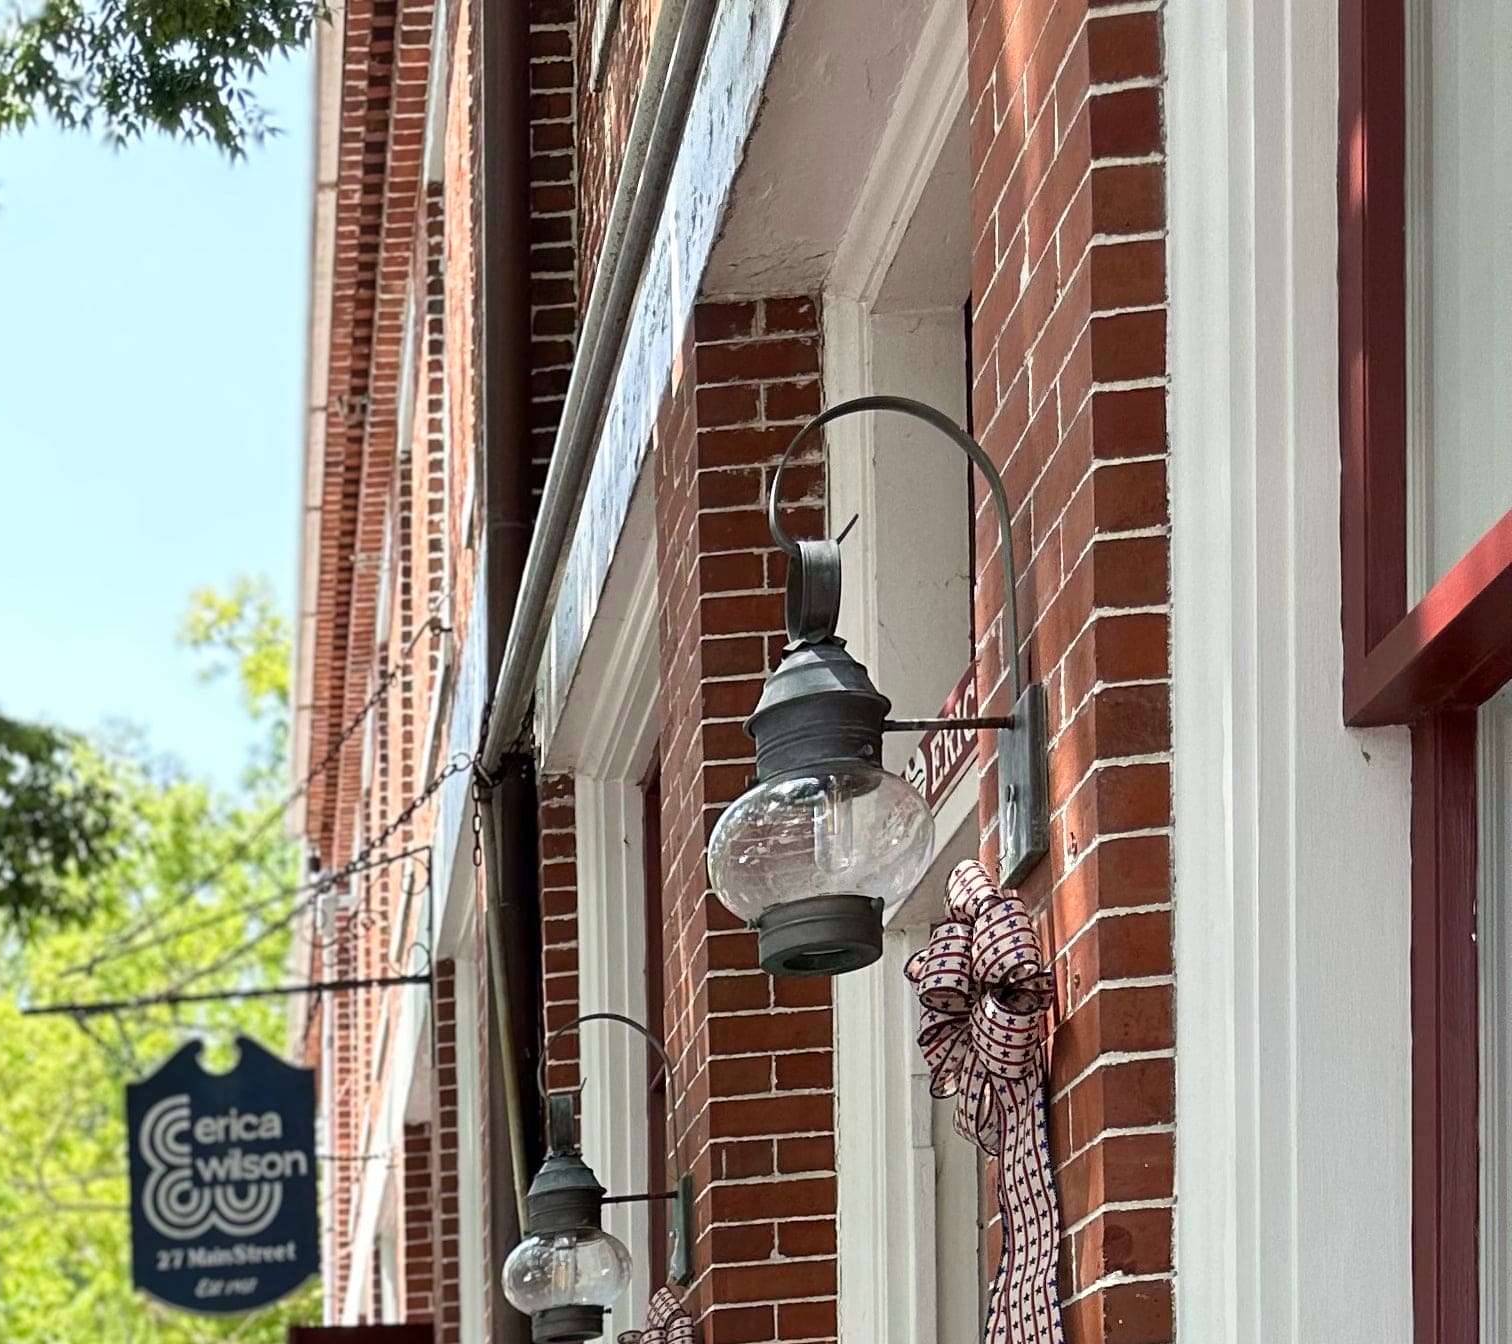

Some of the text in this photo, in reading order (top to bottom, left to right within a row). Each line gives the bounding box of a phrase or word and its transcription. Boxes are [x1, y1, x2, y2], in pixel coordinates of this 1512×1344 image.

[193, 1107, 283, 1145] erica
[196, 1147, 308, 1183] wilson
[156, 1249, 185, 1271] 27
